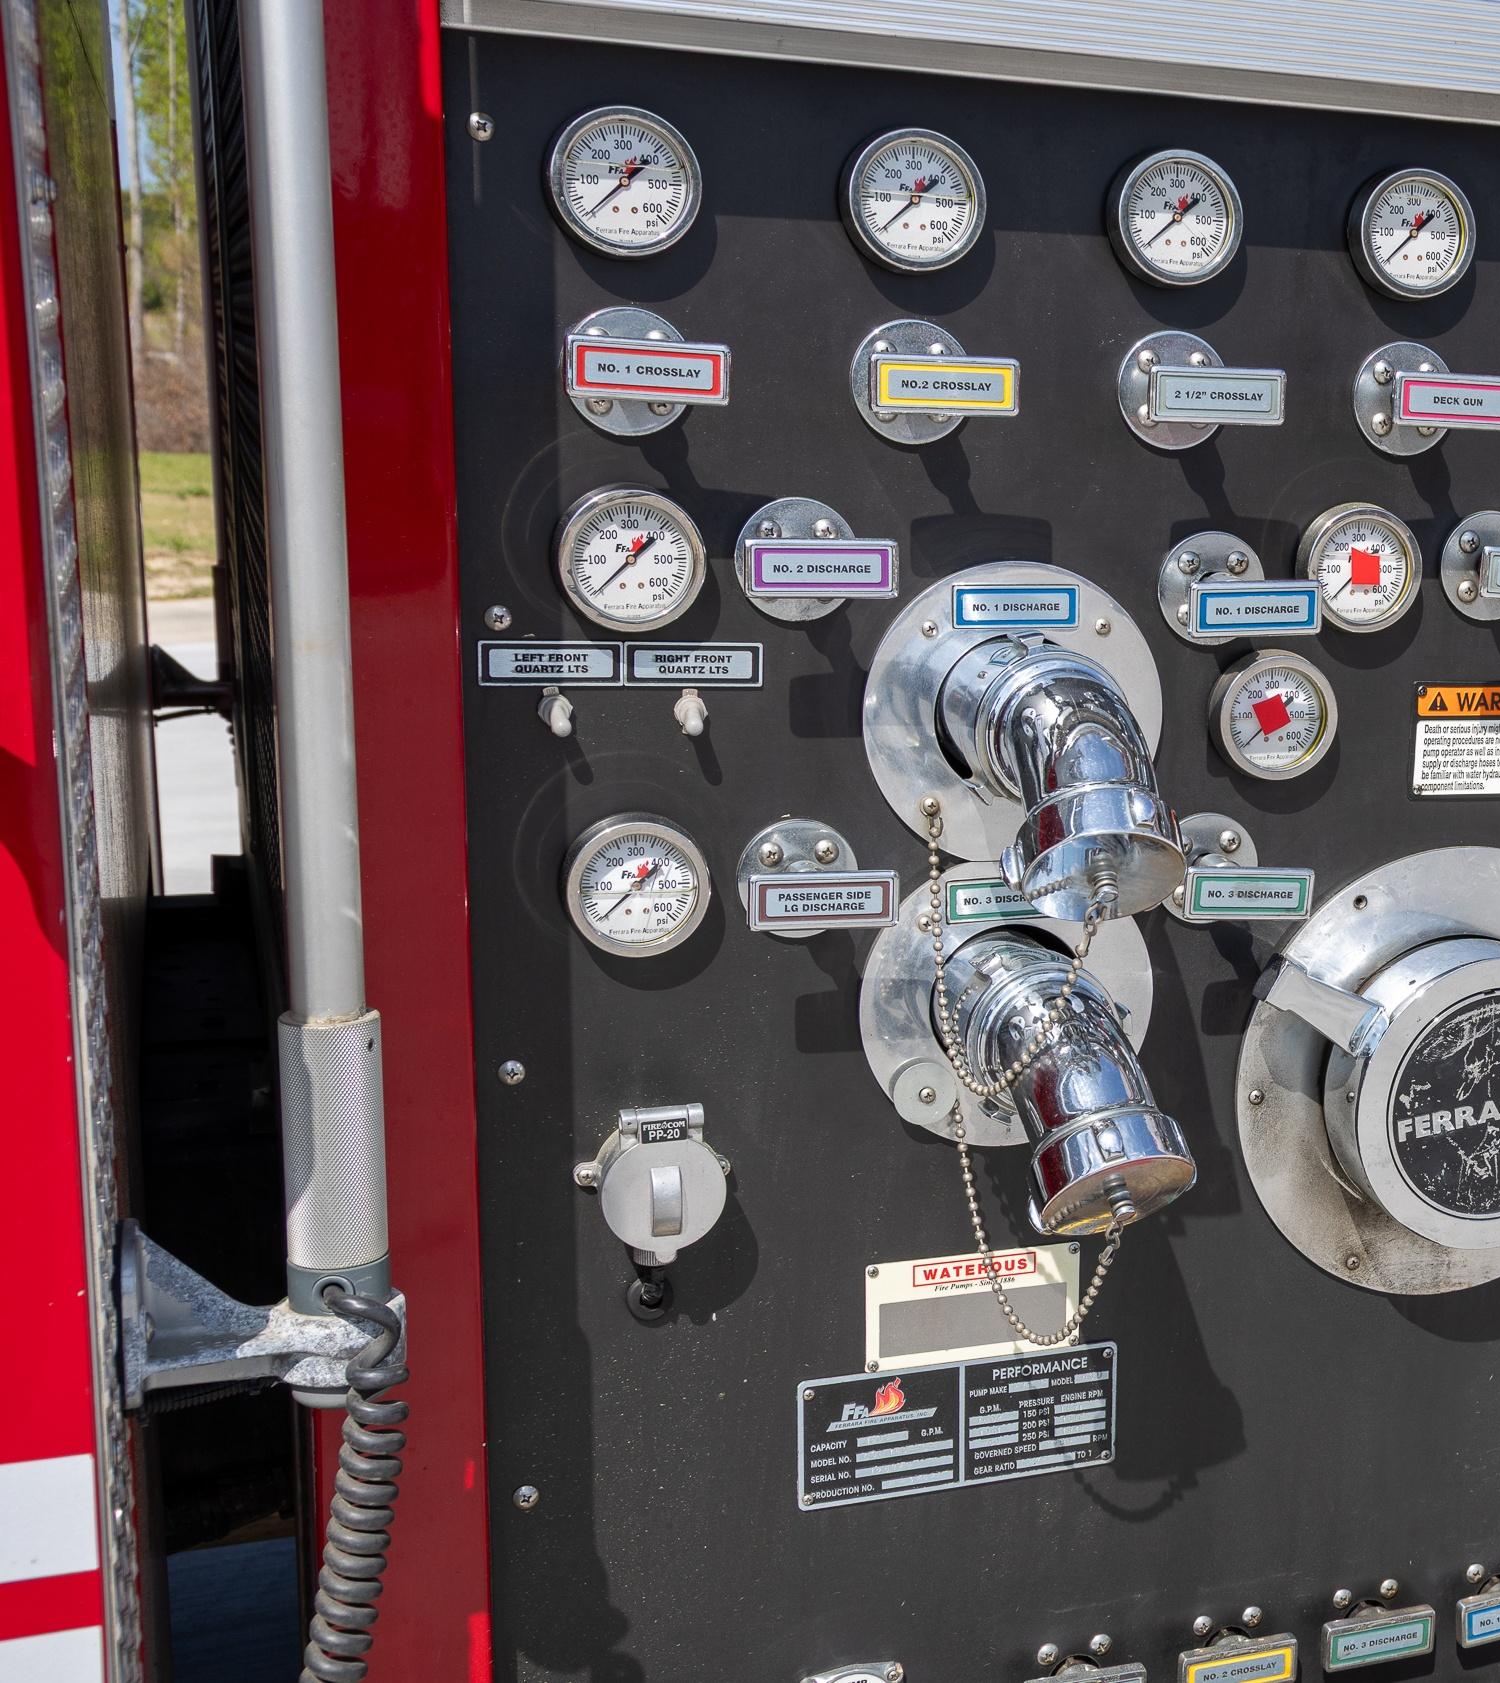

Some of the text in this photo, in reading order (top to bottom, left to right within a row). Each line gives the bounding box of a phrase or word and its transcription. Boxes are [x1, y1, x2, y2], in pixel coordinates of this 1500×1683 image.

[614, 140, 632, 150] 300
[591, 149, 610, 160] 200
[648, 179, 668, 190] 500
[642, 203, 662, 214] 600
[598, 363, 701, 378] NO. 1 CROSSLAY
[901, 379, 992, 391] NO.2 CROSSLAY
[1174, 390, 1181, 399] 2
[1210, 391, 1263, 401] CROSSLAY
[1433, 396, 1483, 407] DECK GUN
[621, 519, 639, 529] 300
[599, 530, 618, 540] 200
[588, 555, 606, 564] 100
[654, 555, 673, 564] 500
[773, 565, 871, 573] NO. 2 DISCHARGE
[649, 577, 668, 588] 600
[1003, 603, 1060, 611] DISCHARGE
[1236, 607, 1241, 615] 1
[1245, 606, 1300, 614] DISCHARGE
[514, 653, 588, 662] LEFT FRONT
[655, 654, 732, 664] RIGHT FRONT
[515, 664, 589, 673] QUARTZ LTS
[658, 665, 729, 674] QUARTZ LTS
[1424, 725, 1442, 734] Death
[1450, 725, 1471, 734] serious
[627, 847, 645, 857] 300
[606, 857, 624, 867] 200
[658, 880, 677, 889] 500
[778, 891, 872, 901] PASSENGER SIDE
[964, 894, 1026, 906] NO. 3 DISCH
[1208, 890, 1225, 898] NO.
[1237, 890, 1293, 899] DISCHARGE
[653, 902, 672, 912] 600
[784, 902, 865, 913] LG DISCHARGE
[649, 1129, 680, 1141] PP-20
[923, 1258, 1029, 1281] WATEROUS
[934, 1284, 949, 1293] Fire
[951, 1282, 974, 1291] Pumps
[1000, 1276, 1015, 1284] 1886
[992, 1357, 1088, 1381] PERFORMANCE
[969, 1377, 1074, 1398] PUMP MAKE MODEL
[1060, 1390, 1103, 1402] ENGINE RPM
[979, 1397, 1055, 1414] G.P.M. PRESSURE
[810, 1427, 943, 1453] CAPACITY G.P.M.
[810, 1456, 851, 1468] MODEL NO.
[810, 1476, 836, 1484] SERIAL
[812, 1484, 874, 1499] PRODUCTION NO.
[1480, 1619, 1493, 1627] NO.
[1343, 1644, 1358, 1652] NO.
[1369, 1632, 1418, 1647] DISCHARGE
[1203, 1673, 1219, 1681] NO.
[1230, 1662, 1277, 1676] CROSSLAY
